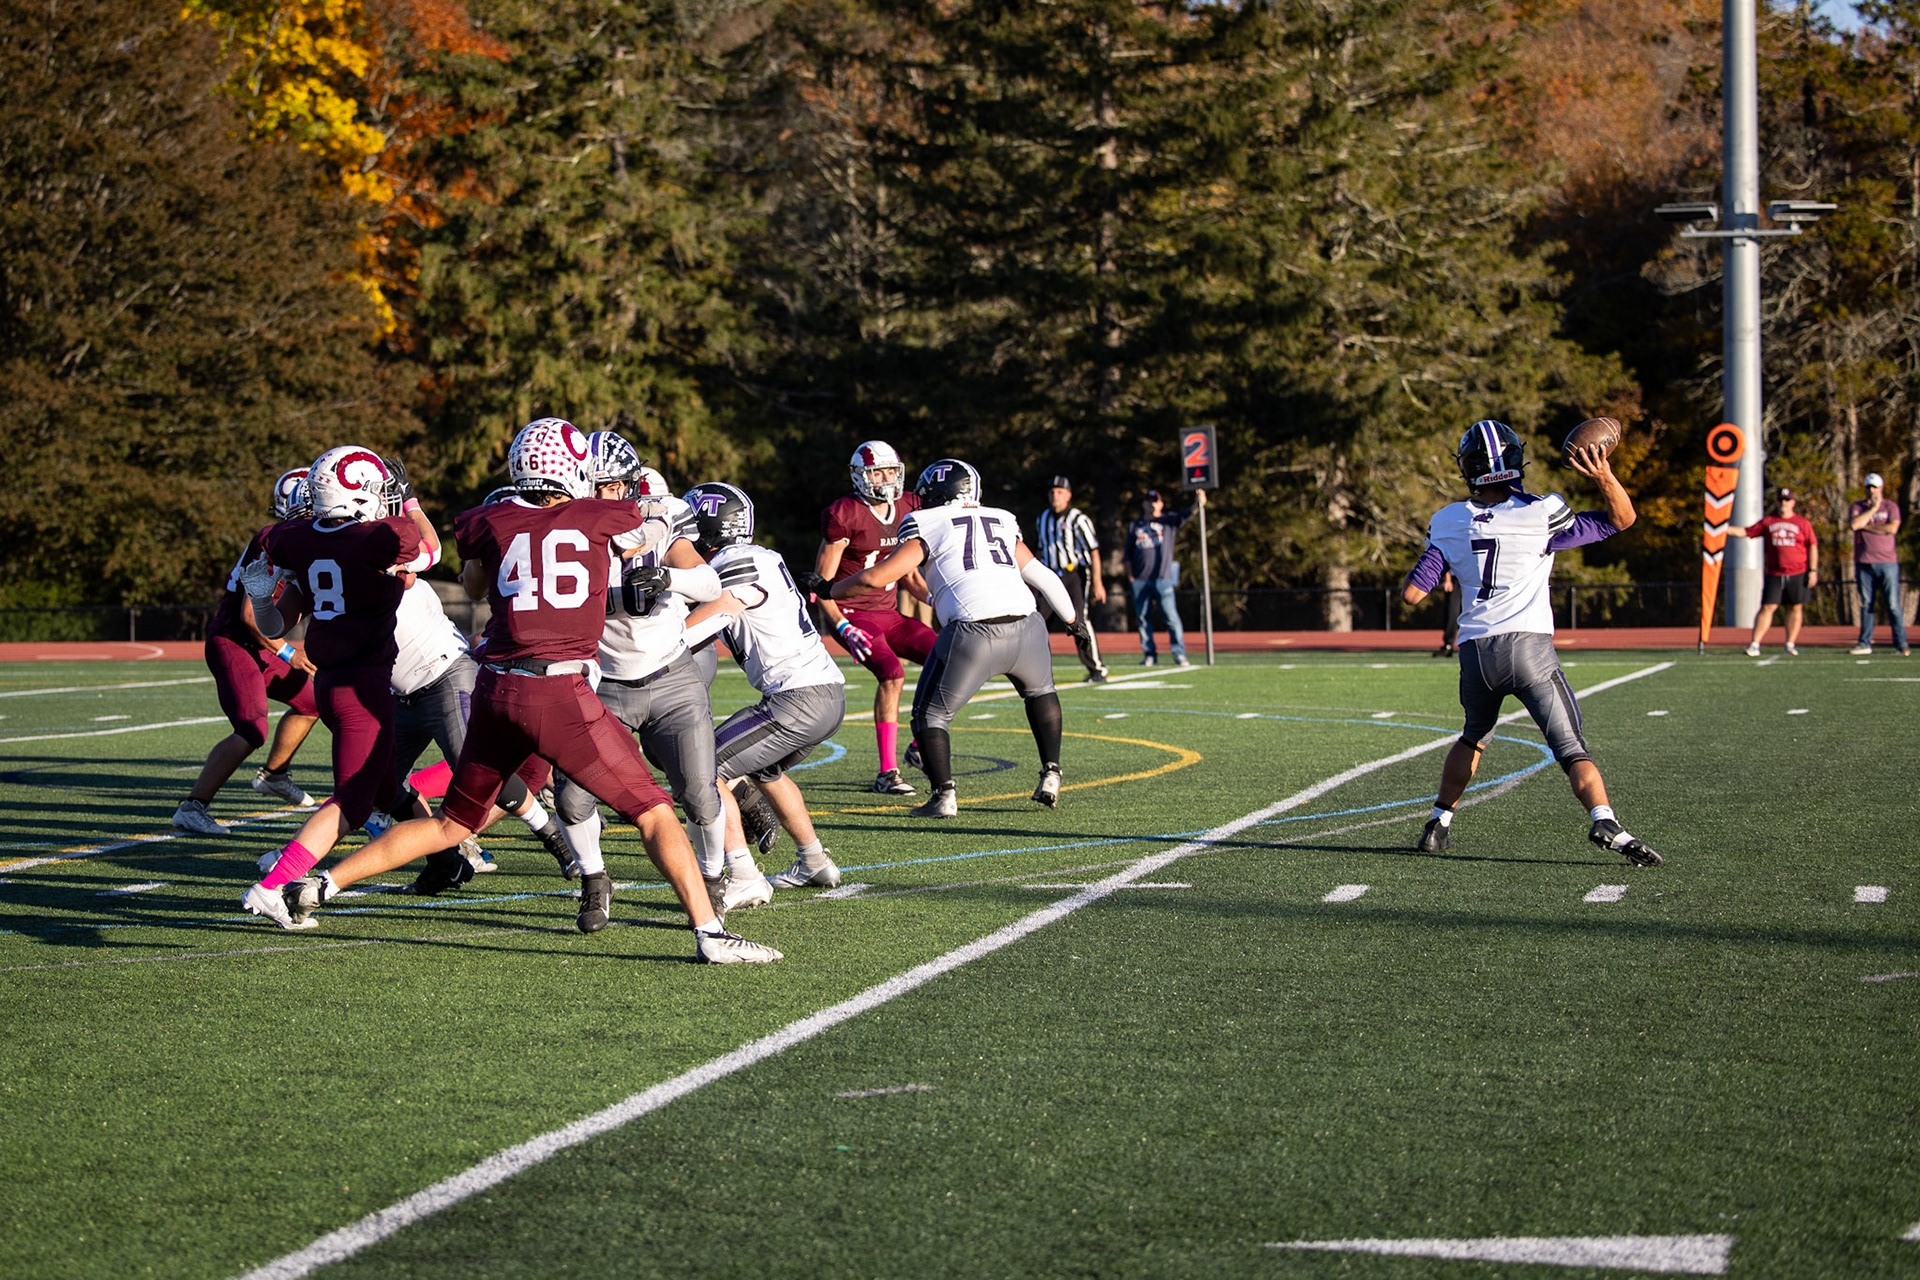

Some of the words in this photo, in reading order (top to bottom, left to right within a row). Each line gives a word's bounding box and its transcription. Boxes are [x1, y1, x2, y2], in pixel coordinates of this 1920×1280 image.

[1184, 432, 1208, 467] 2
[1483, 471, 1514, 483] Riddell
[498, 529, 590, 611] 46
[951, 515, 1015, 570] 75
[1471, 538, 1500, 603] 7
[308, 559, 346, 620] 8
